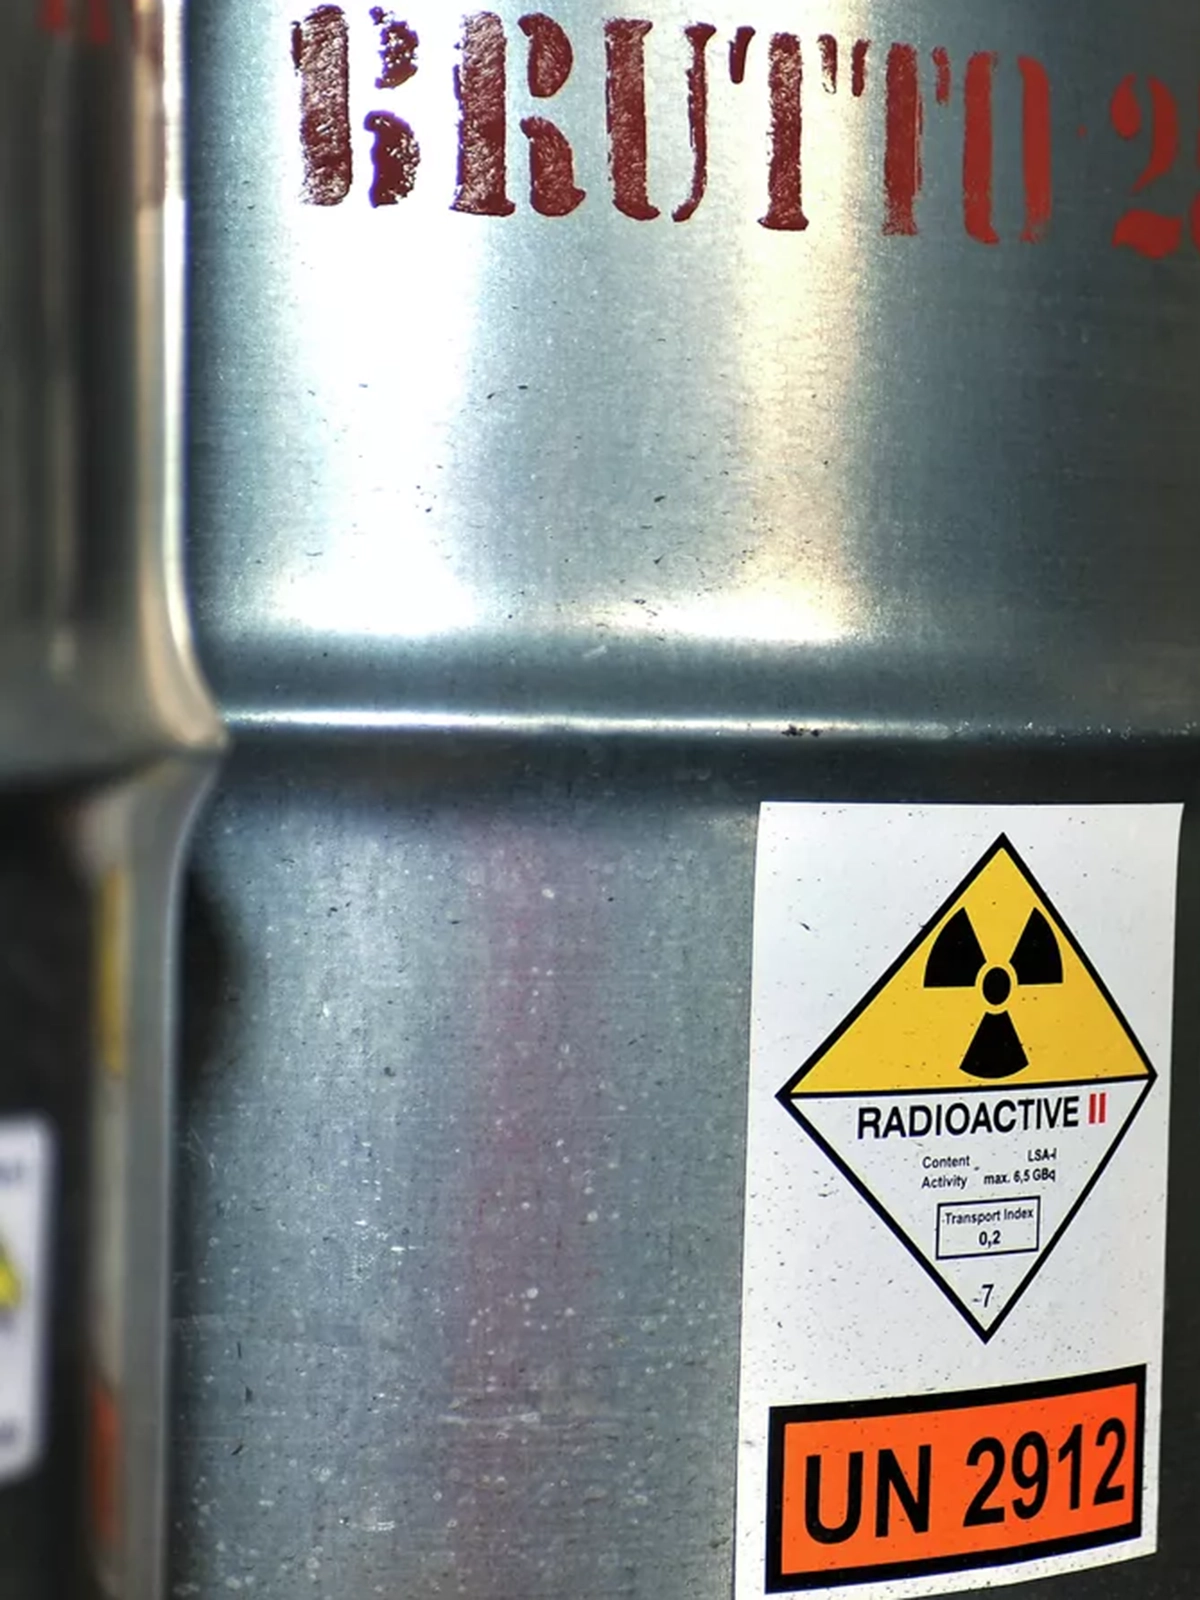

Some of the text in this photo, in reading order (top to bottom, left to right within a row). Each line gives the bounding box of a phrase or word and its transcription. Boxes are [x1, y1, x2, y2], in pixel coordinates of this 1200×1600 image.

[292, 4, 1053, 244] BRUTTO
[857, 1092, 1107, 1140] RADIOACTIVE II
[922, 1155, 970, 1169] Content
[921, 1167, 1056, 1190] Activity max. 6,5 GBq
[944, 1207, 1034, 1226] Transport Index
[978, 1230, 1001, 1249] 0,2
[805, 1417, 1127, 1545] UN 2912
